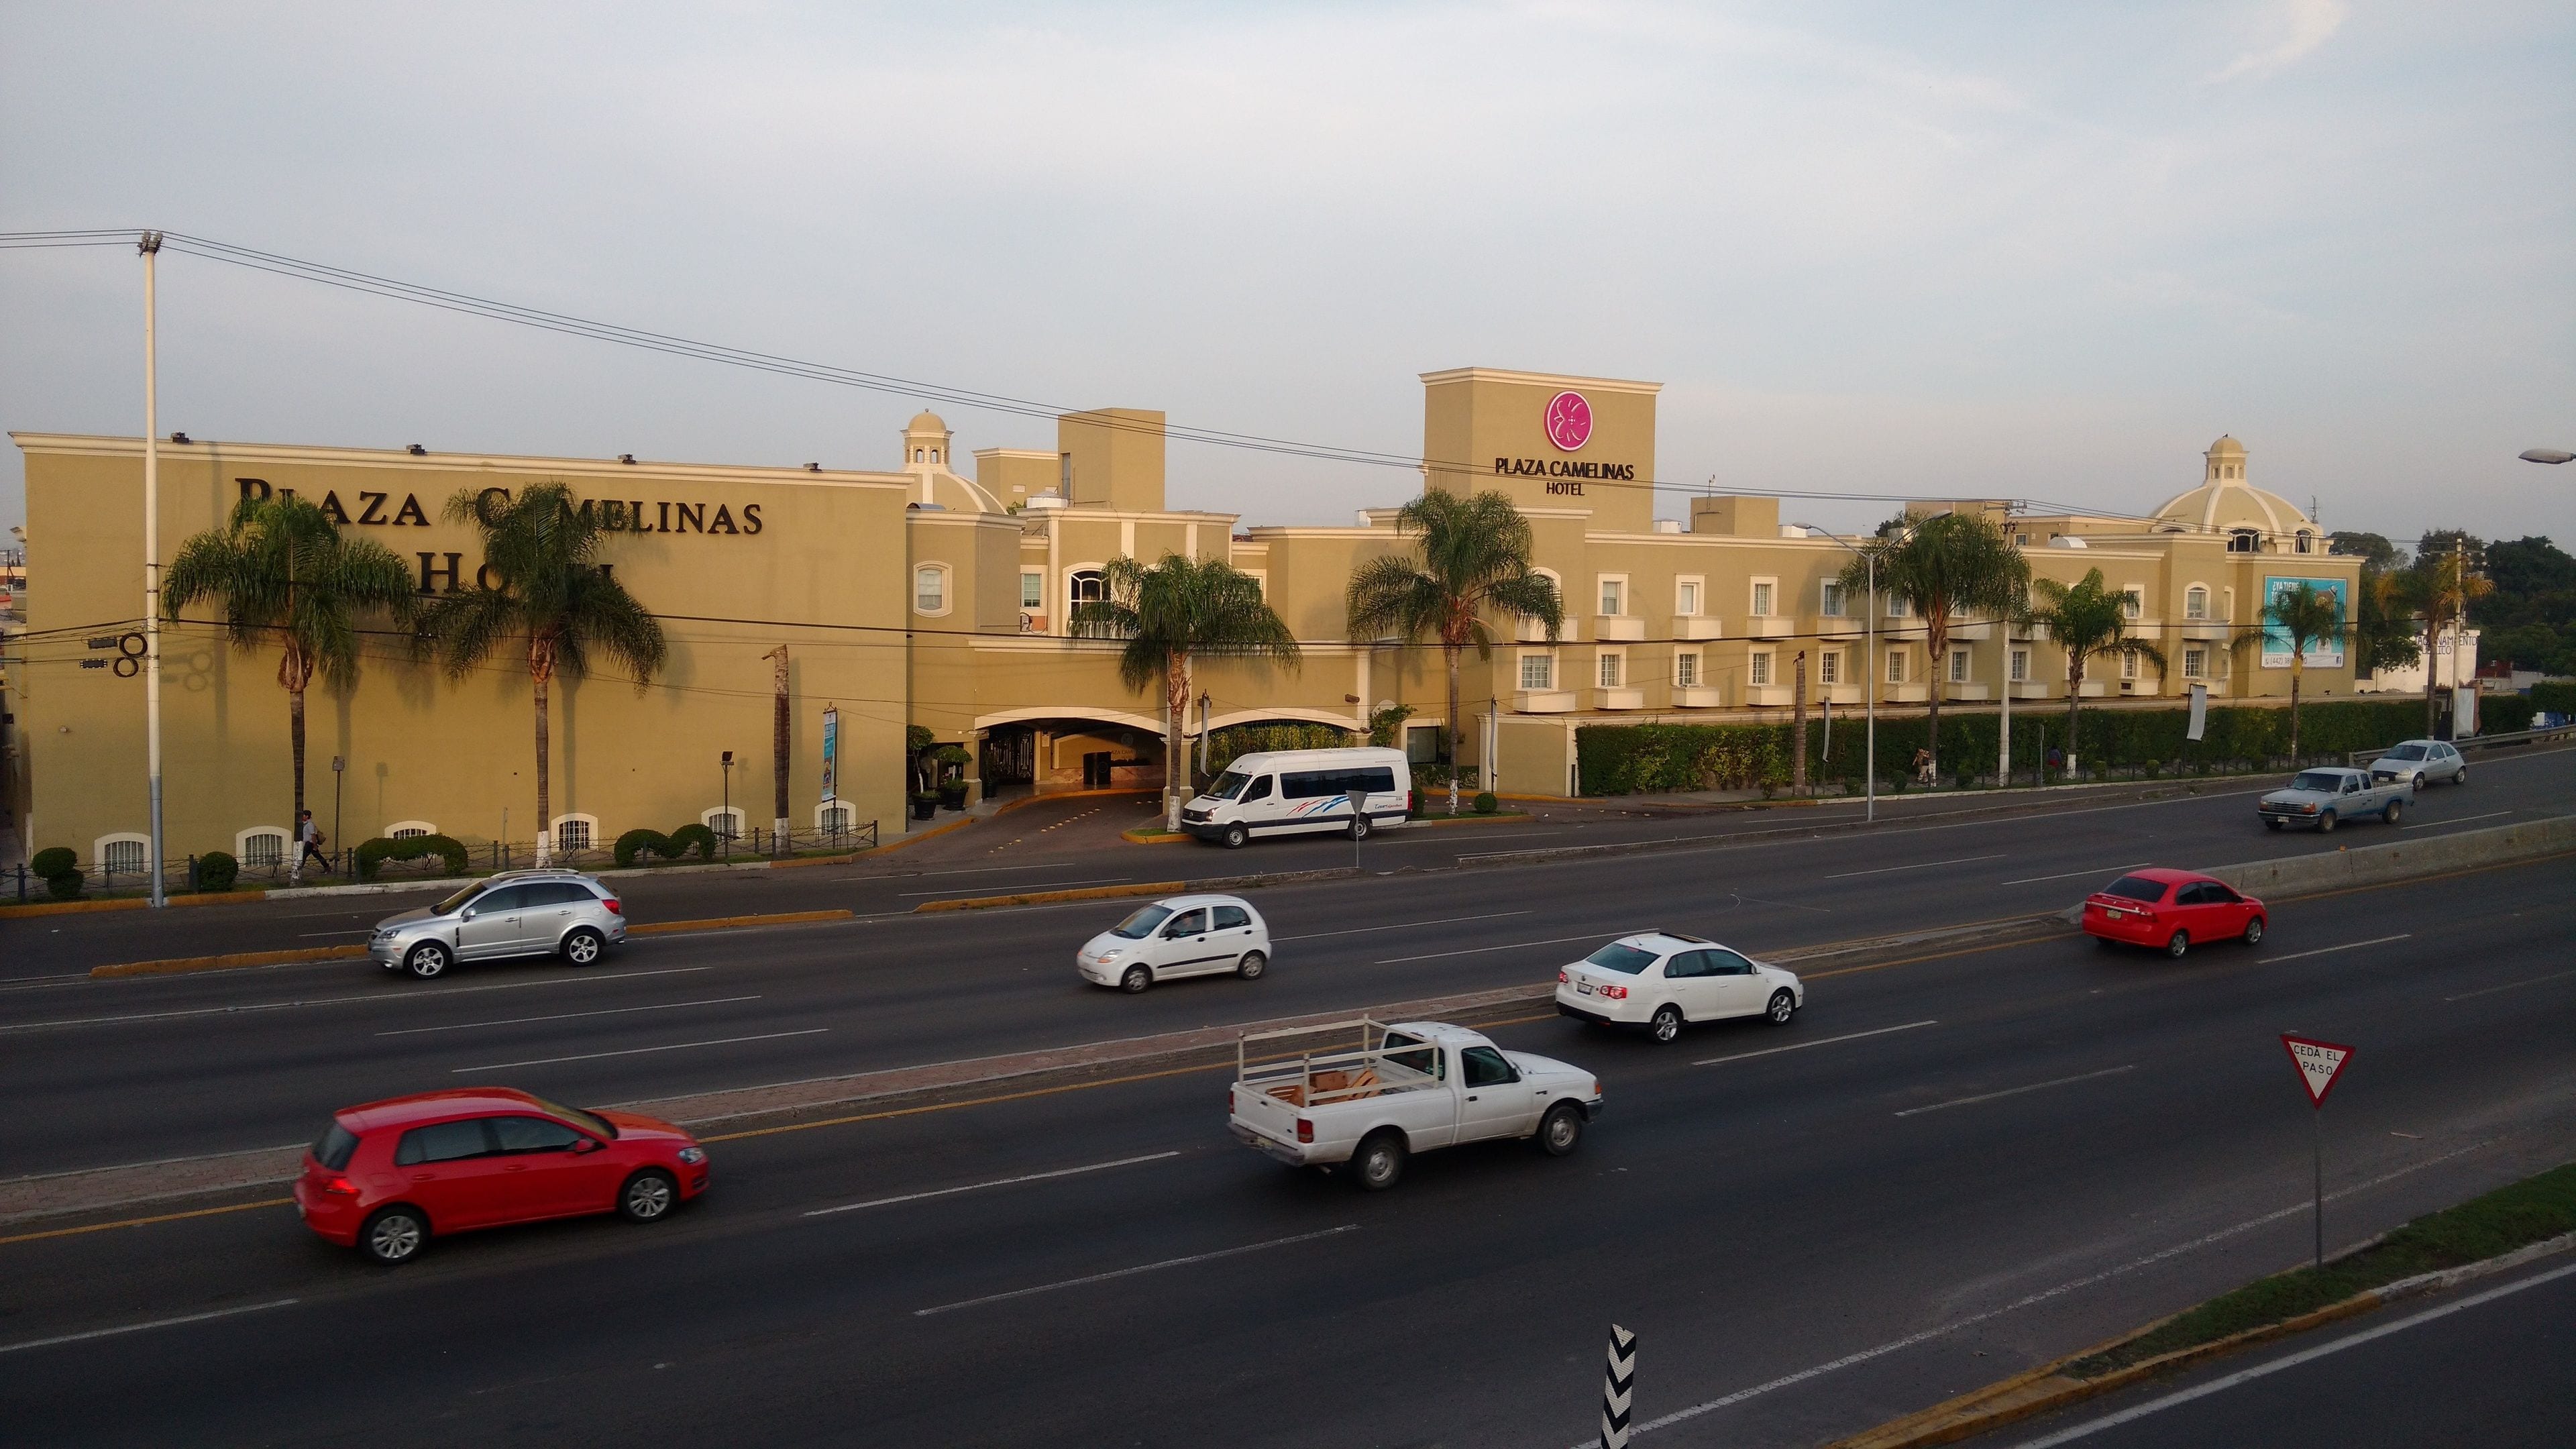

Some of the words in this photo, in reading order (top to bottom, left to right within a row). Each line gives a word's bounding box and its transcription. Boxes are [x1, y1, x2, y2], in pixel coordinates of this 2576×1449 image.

[1495, 458, 1546, 476] PLAZA
[1550, 461, 1634, 480] CAMELINAS
[1546, 482, 1585, 496] HOTEL
[475, 487, 763, 535] CMELINAS
[2294, 1044, 2320, 1059] CEDA
[2326, 1051, 2340, 1062] EL
[2302, 1061, 2332, 1075] PASO
